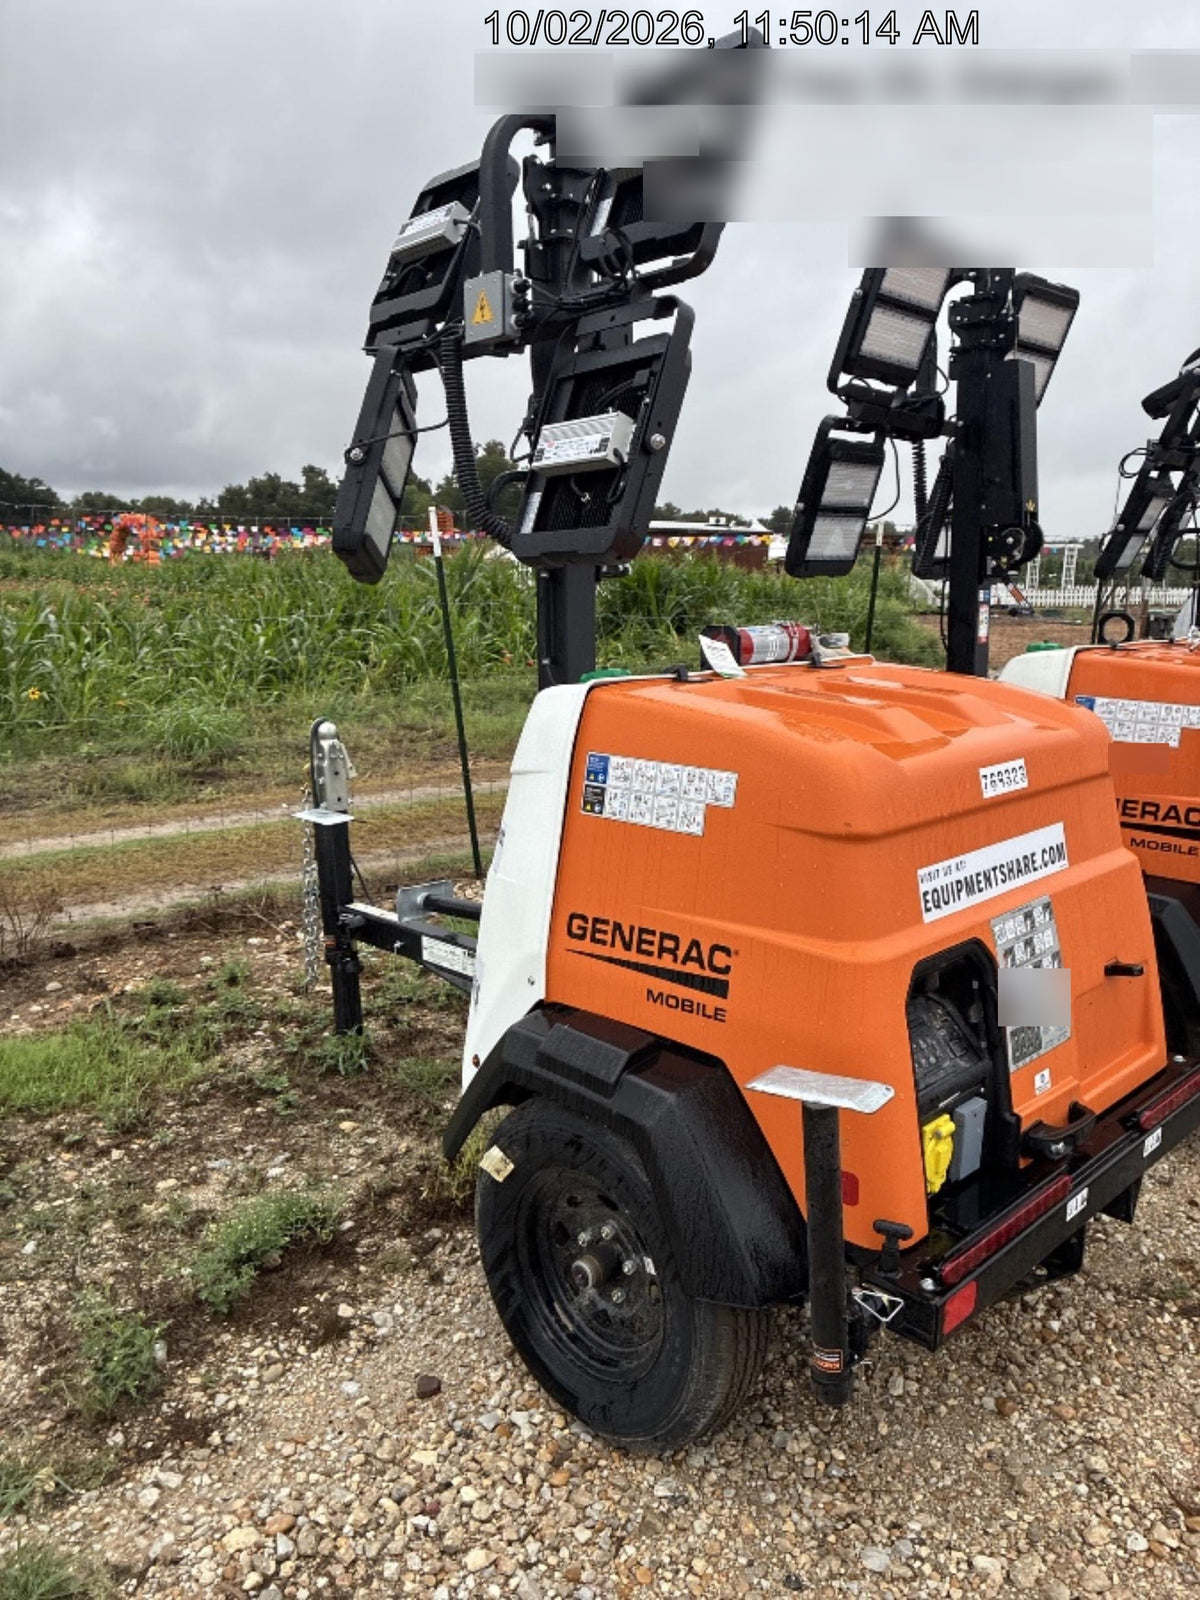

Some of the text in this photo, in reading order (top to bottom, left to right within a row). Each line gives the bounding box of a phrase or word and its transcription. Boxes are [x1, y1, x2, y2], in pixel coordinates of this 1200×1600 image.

[1115, 797, 1200, 827] ERAC
[1130, 837, 1200, 856] MOBILE
[922, 841, 1067, 913] EQUIPMENTSHARE.COM
[565, 911, 733, 976] GENERAC
[646, 988, 728, 1023] MOBILE
